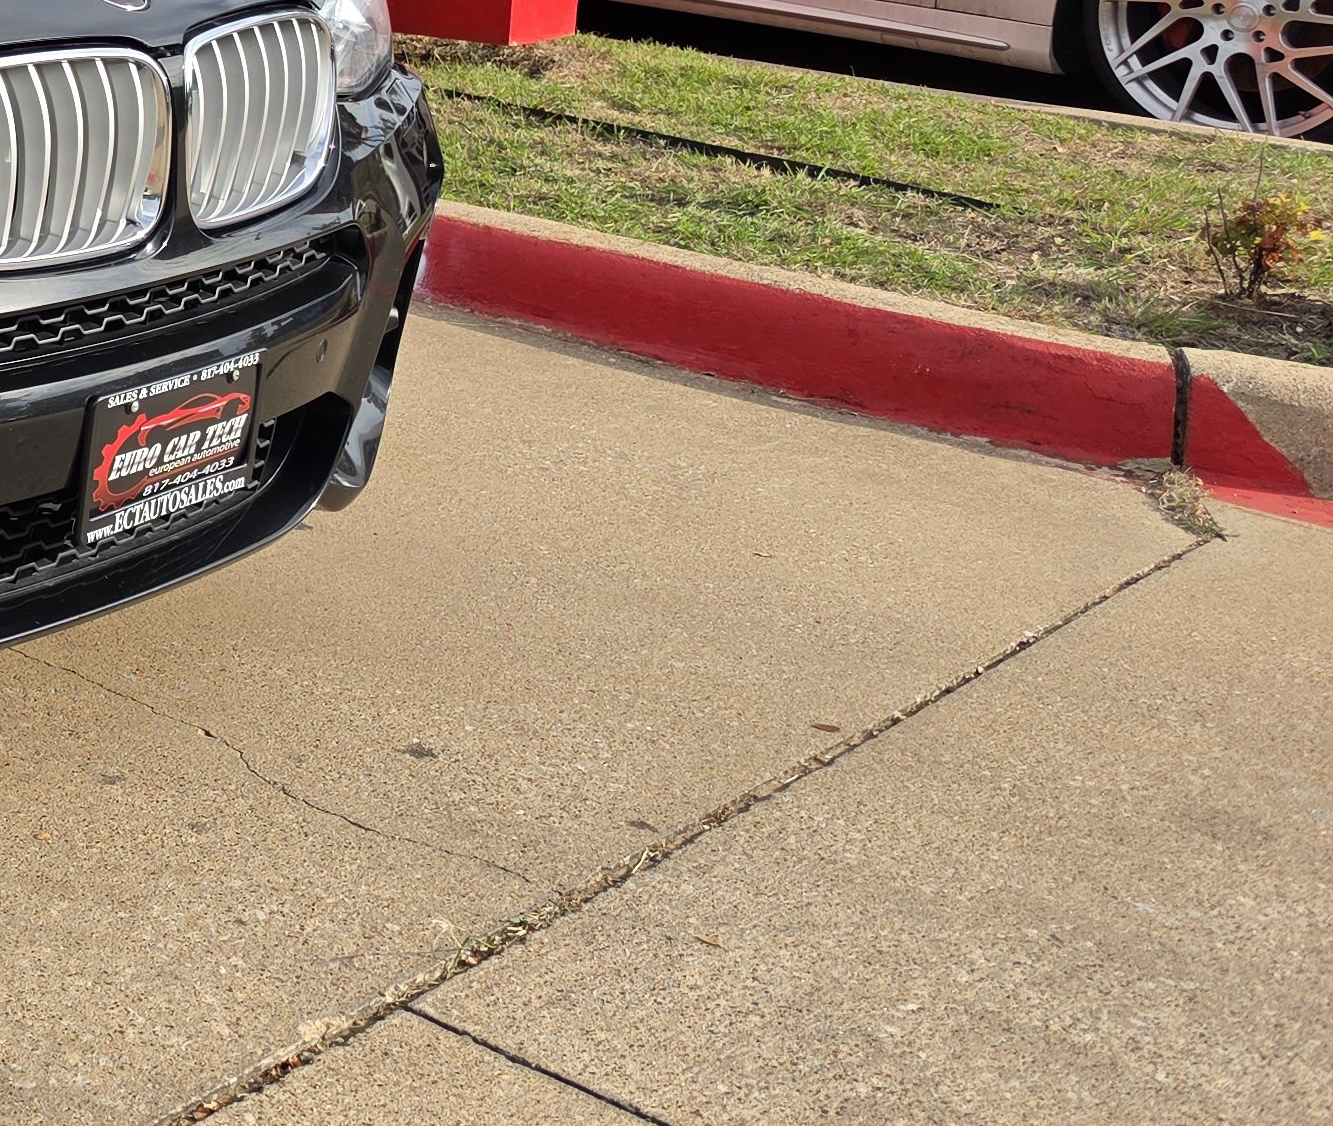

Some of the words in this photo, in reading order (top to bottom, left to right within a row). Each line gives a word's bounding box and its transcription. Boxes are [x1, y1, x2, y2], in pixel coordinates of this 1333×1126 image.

[107, 389, 138, 409] SALES
[139, 387, 149, 399] &
[149, 374, 191, 397] SERVICE
[200, 352, 260, 381] 817-404-4033
[108, 443, 159, 482] EURO
[163, 431, 202, 463] CAR
[201, 414, 249, 450] TECH
[142, 456, 235, 497] 817-404-4033
[148, 456, 192, 477] european
[192, 438, 242, 462] automotive
[86, 475, 246, 545] www.ECTAUTOSALES.com
